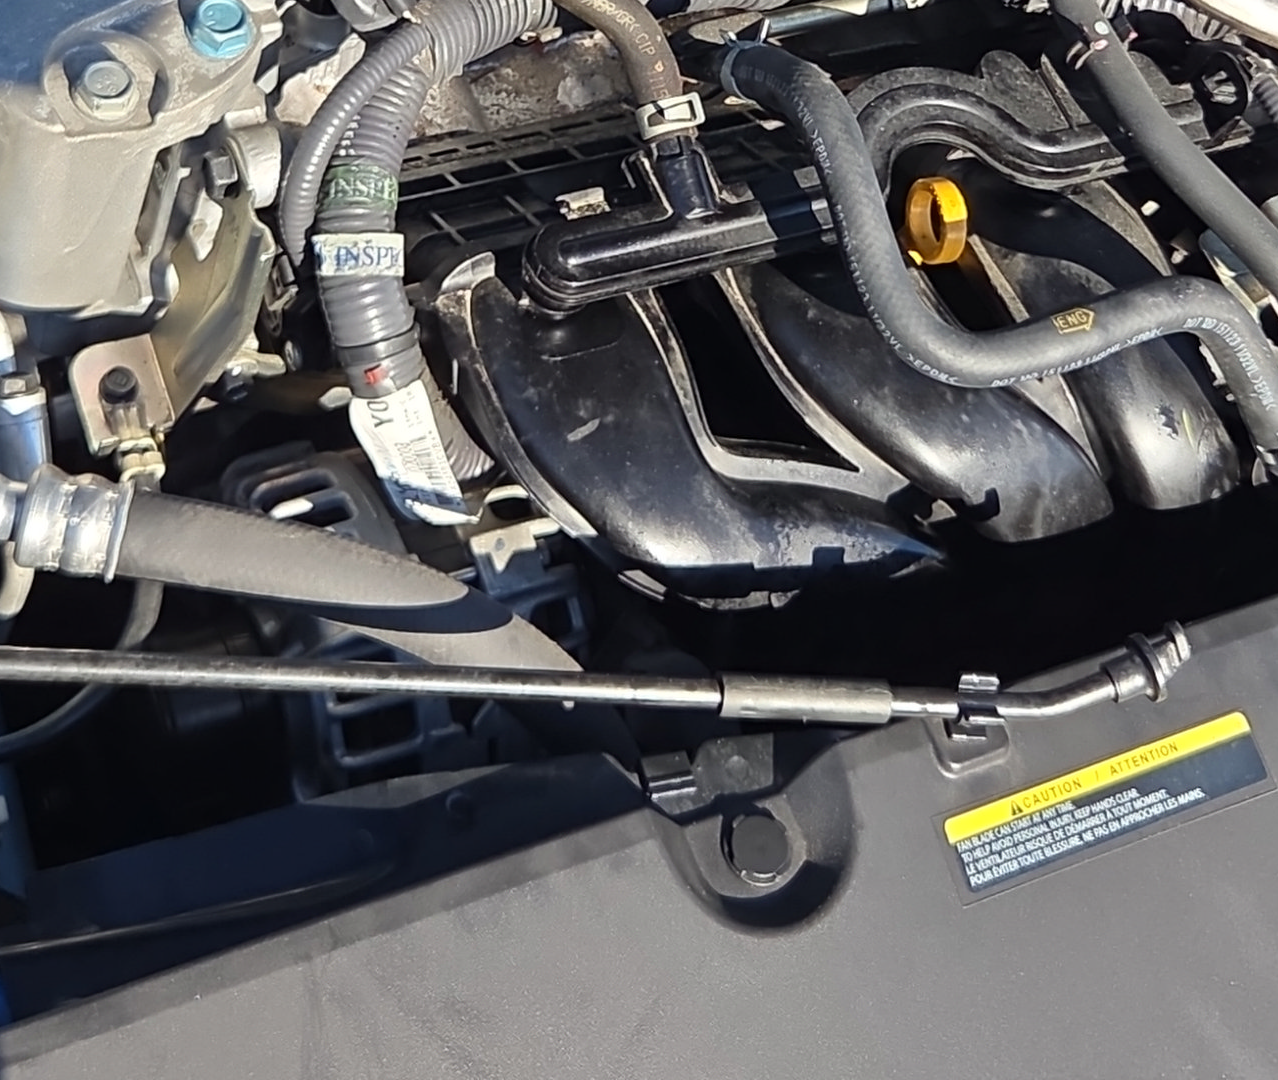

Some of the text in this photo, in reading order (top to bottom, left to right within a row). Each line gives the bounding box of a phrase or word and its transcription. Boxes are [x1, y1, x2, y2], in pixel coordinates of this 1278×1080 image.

[1056, 309, 1087, 328] ENG
[1212, 322, 1241, 346] 151123
[1021, 777, 1082, 809] CAUTION
[1107, 740, 1179, 776] ATTENTION
[955, 837, 973, 852] FAN
[971, 829, 996, 846] BLADE
[993, 823, 1011, 838] CAN
[1009, 815, 1032, 832] START
[1030, 811, 1042, 824] AT
[1040, 806, 1057, 820] ANY
[960, 849, 973, 862] TO
[971, 842, 991, 858] HELP
[989, 834, 1014, 851] AVOID
[1012, 821, 1049, 843] PERSONAL
[1073, 805, 1091, 820] KEEP
[1089, 795, 1116, 813] HANDS
[964, 861, 976, 874] LE
[974, 842, 1026, 871] VENTILATEUR
[1024, 832, 1052, 851] RISQUE
[1050, 827, 1066, 841] DE
[1064, 811, 1106, 836] DÉMARRER
[1111, 801, 1133, 817] TOUT
[968, 868, 993, 886] POUR
[991, 858, 1020, 877] ÉVITER
[1017, 848, 1045, 867] TOUTE
[1081, 829, 1095, 842] NE
[1092, 823, 1109, 838] PAS
[1107, 819, 1120, 832] EN
[1118, 801, 1165, 828] APPROCHER
[1163, 796, 1179, 810] LES
